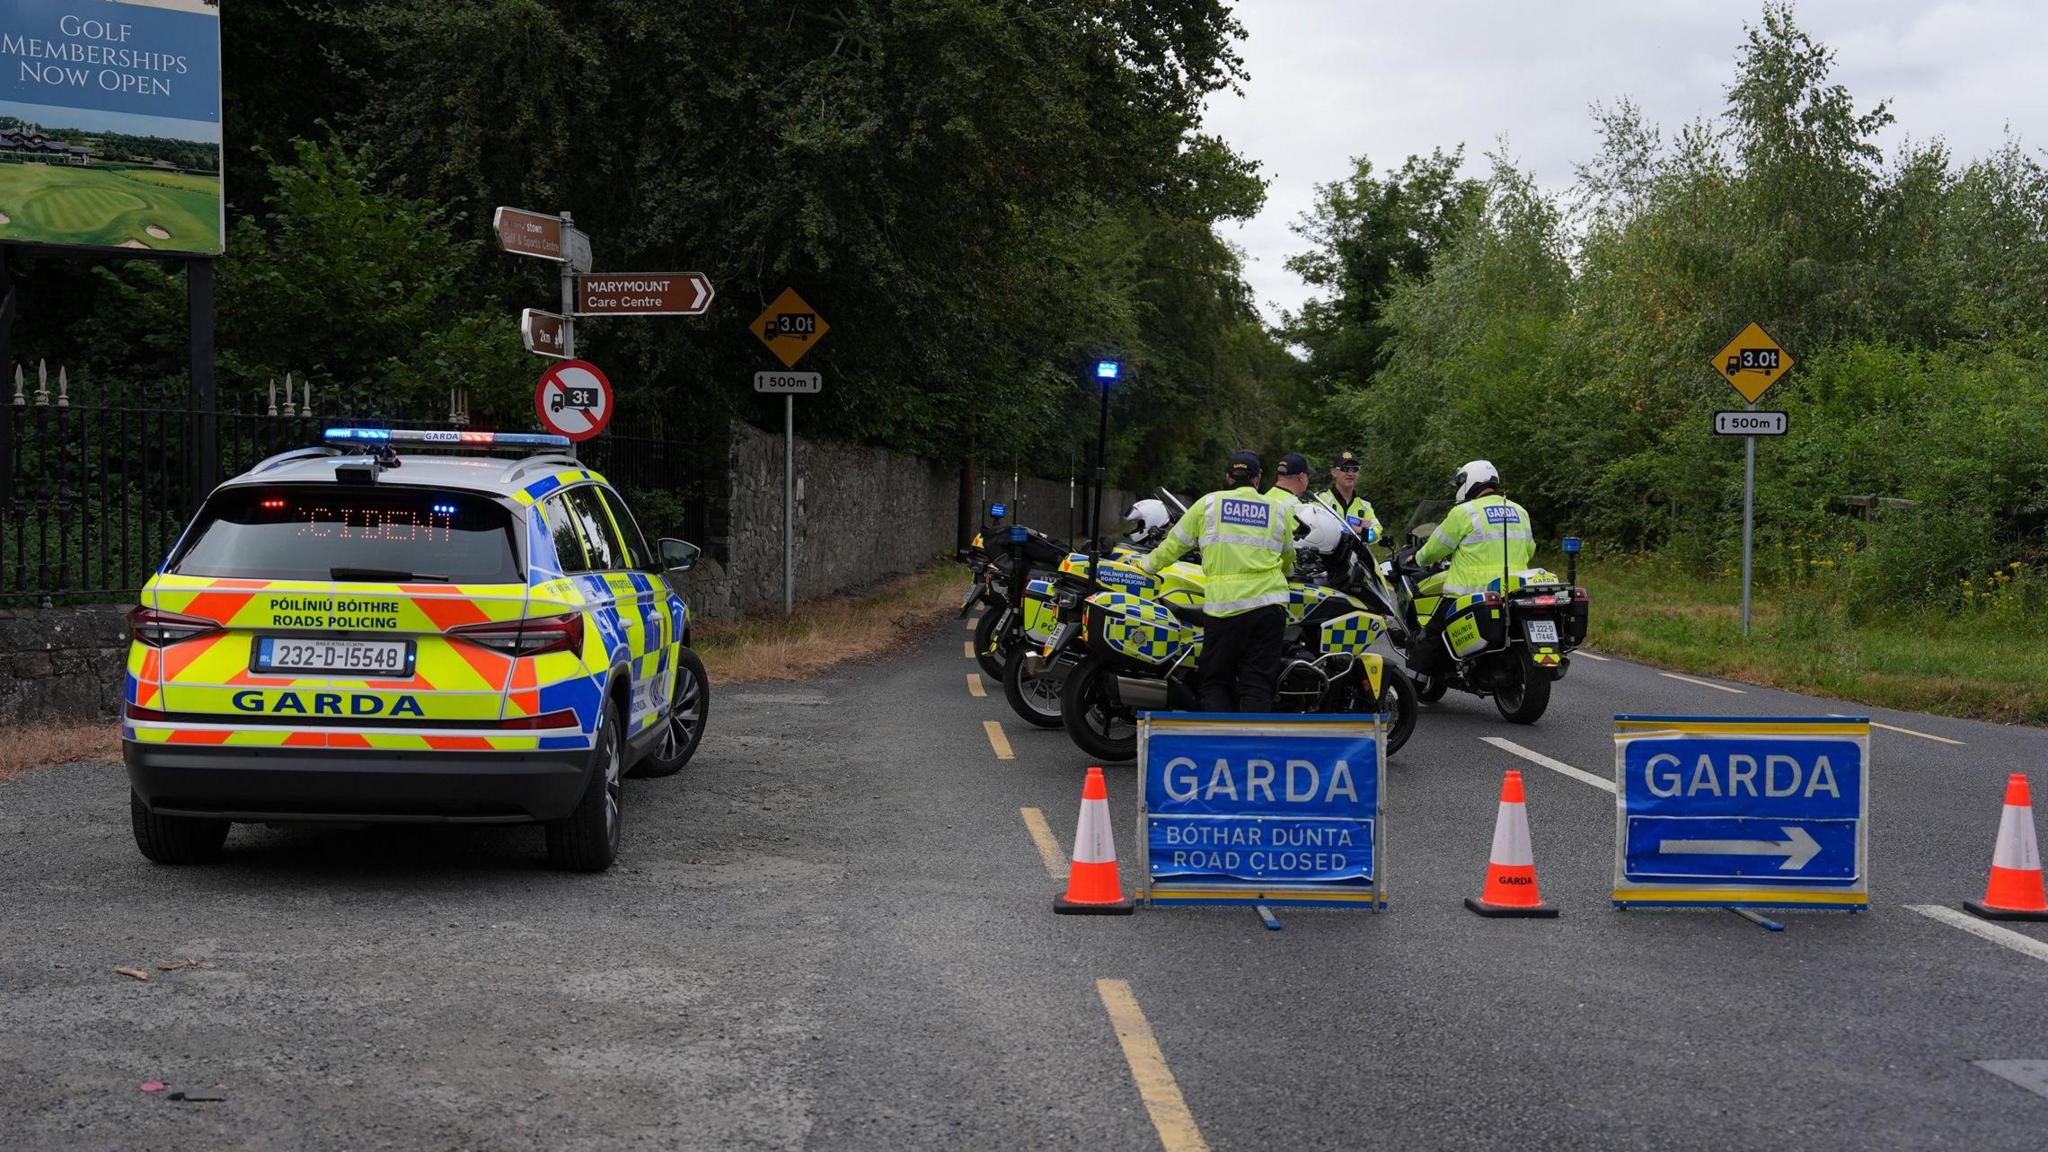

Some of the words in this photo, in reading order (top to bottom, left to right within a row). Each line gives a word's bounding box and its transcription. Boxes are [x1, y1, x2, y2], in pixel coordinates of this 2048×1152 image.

[587, 280, 671, 292] MARYMOUNT
[588, 296, 617, 308] Care
[621, 296, 663, 308] Centre
[781, 316, 813, 333] 3.0t
[1743, 352, 1778, 366] 3.0t
[769, 376, 807, 388] 500m
[573, 390, 590, 404] 3t
[1732, 418, 1770, 429] 500m
[1223, 502, 1267, 519] GARDA
[1486, 507, 1519, 518] GARDA
[271, 597, 333, 612] PÓILÍNIÚ
[337, 599, 399, 613] BÓITHRE
[273, 615, 323, 627] ROADS
[328, 617, 397, 629] POLICING
[278, 646, 398, 668] 232-D-15548
[232, 690, 425, 717] GARDA
[1163, 757, 1358, 803] GARDA
[1644, 753, 1841, 798] GARDA
[1166, 822, 1261, 846] BÓTHAR
[1272, 823, 1352, 847] DÚNTA
[1174, 850, 1240, 869] ROAD
[1250, 852, 1347, 871] CLOSED
[1499, 876, 1533, 885] GARDA
